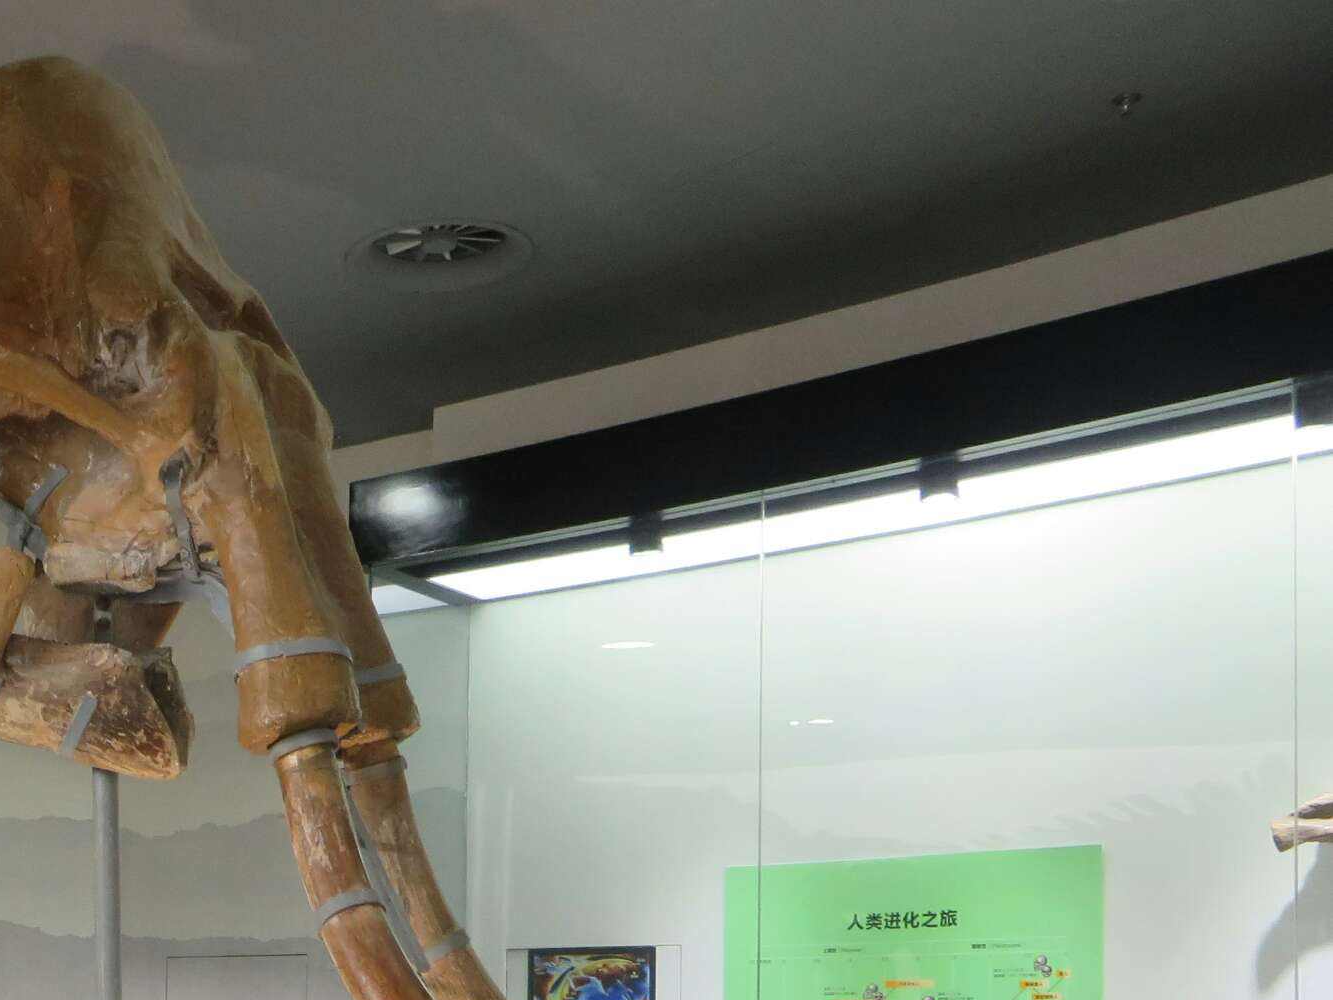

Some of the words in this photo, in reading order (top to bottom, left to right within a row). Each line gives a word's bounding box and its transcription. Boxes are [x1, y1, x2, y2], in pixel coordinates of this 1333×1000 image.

[847, 909, 958, 930] 人类进化之旅
